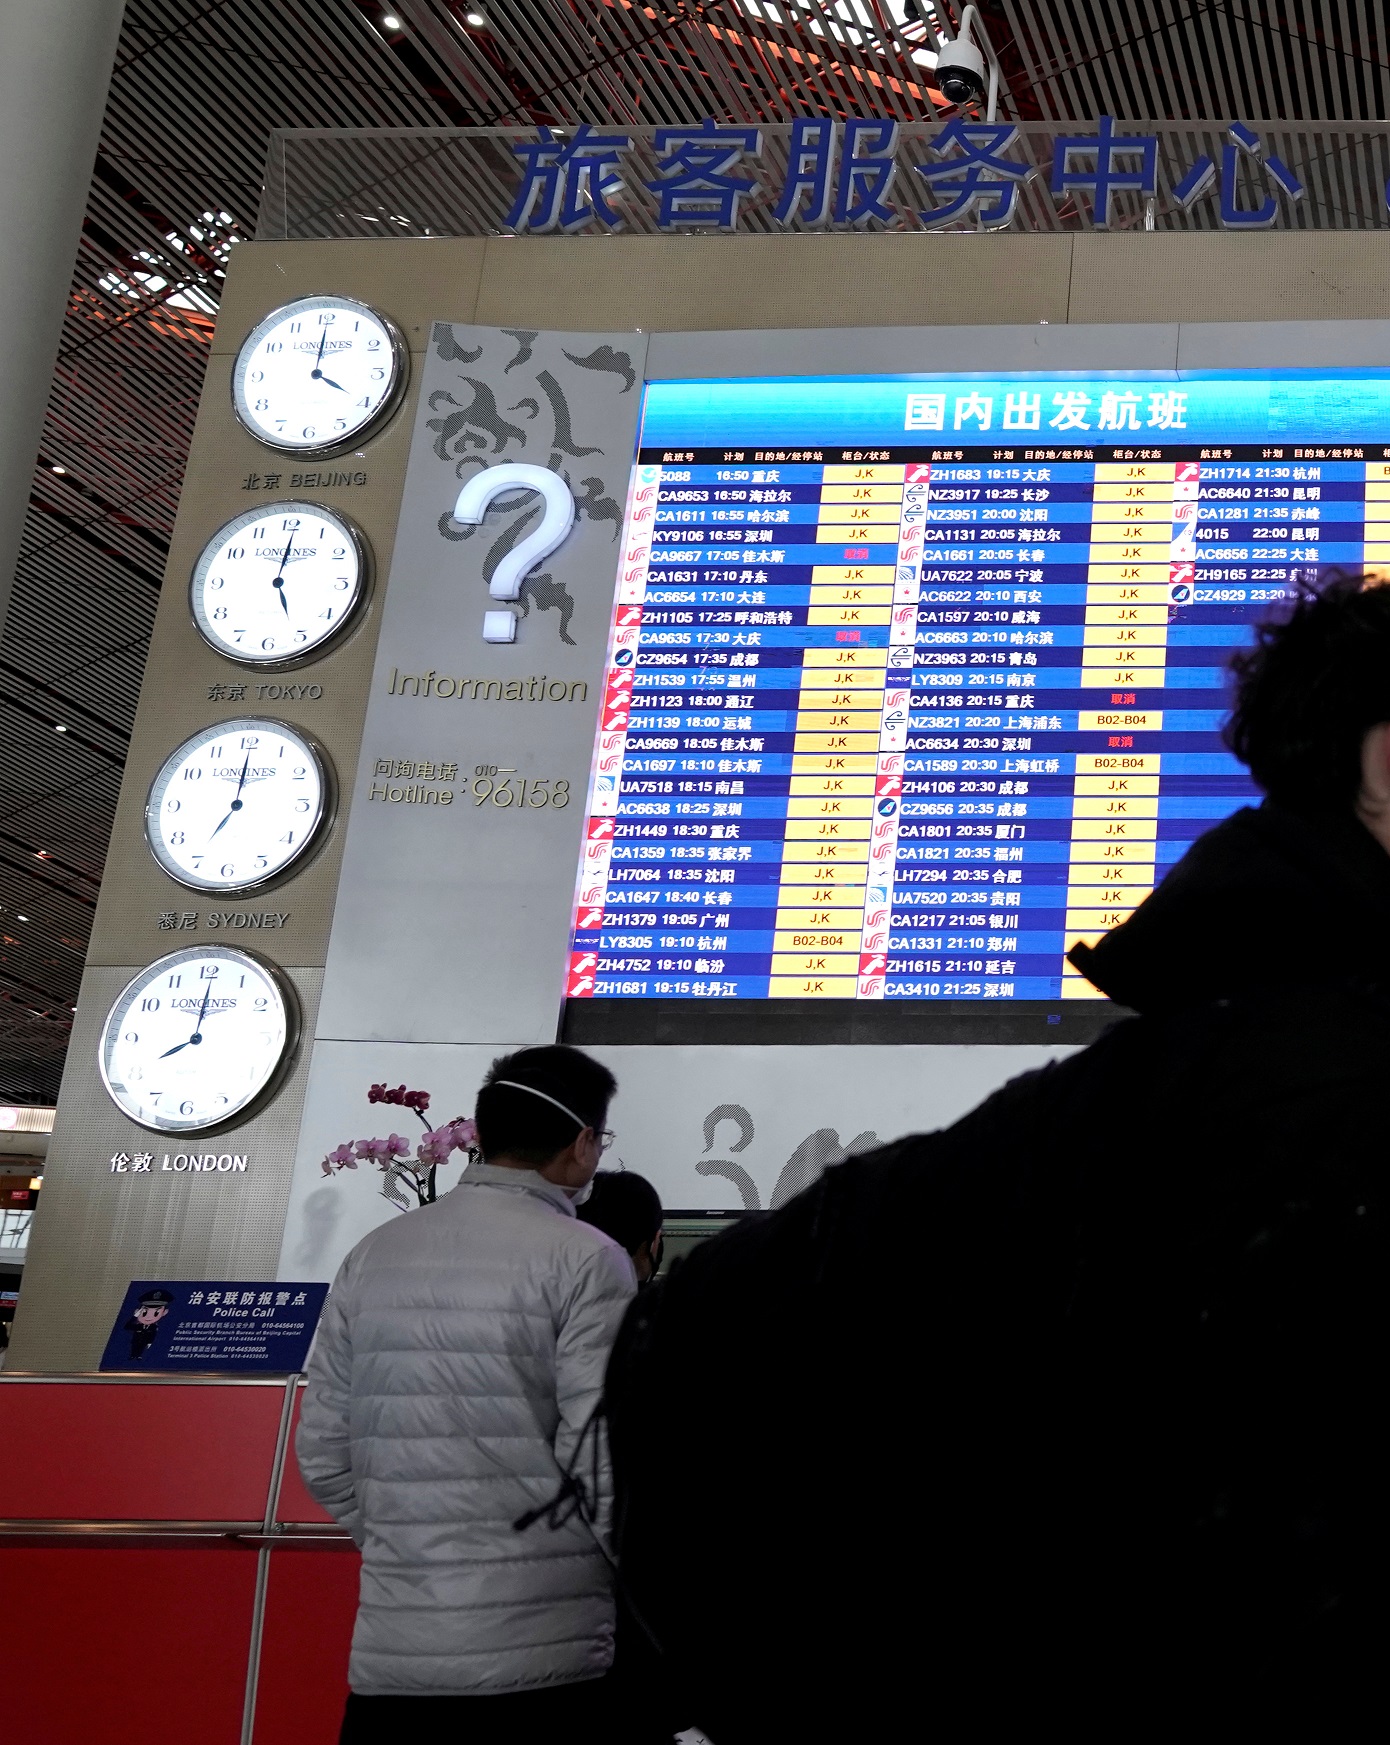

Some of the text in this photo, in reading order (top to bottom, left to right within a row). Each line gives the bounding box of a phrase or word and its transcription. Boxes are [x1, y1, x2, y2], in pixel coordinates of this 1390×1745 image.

[503, 116, 1301, 232] 旅客服务中心
[904, 391, 1188, 431] 国内出发航班
[663, 451, 889, 461] 航班号 计划 目的地/经停站 柜台/状态
[242, 472, 366, 490] 北京 BEIJING
[660, 469, 874, 483] 5088 16:50 重庆 J,K
[930, 467, 1146, 481] ZH1683 19:15 大庆 J,K
[1199, 468, 1250, 480] ZH1714
[1255, 468, 1290, 477] 21:30
[1293, 467, 1320, 480] 杭州
[658, 488, 872, 503] CA9653 16:50 海拉尔 J,K
[653, 528, 868, 542] KY9106 16:55 深圳 J,K
[925, 527, 1142, 542] CA1131 20:05 海拉尔 J,K
[650, 548, 868, 563] CA9667 17:05 佳木斯 取消
[641, 610, 860, 625] ZH1105 17:25 呼和浩特 J,K
[387, 667, 588, 702] Information
[207, 684, 322, 701] 东京 TOKYO
[373, 758, 458, 782] 问询电话
[904, 758, 1144, 773] CA1589 20:30 上海虹桥 B02-B04
[369, 783, 453, 805] Hotline
[158, 912, 289, 930] 悉尼 SYDNEY
[600, 935, 843, 950] LY8305 19:10 杭州 B02-B04
[594, 981, 824, 996] ZH1681 19:15 牡丹江 J,K
[111, 1153, 247, 1172] 伦敦 LONDON
[188, 1291, 307, 1306] 治安联防报警点
[213, 1308, 275, 1317] Police Call
